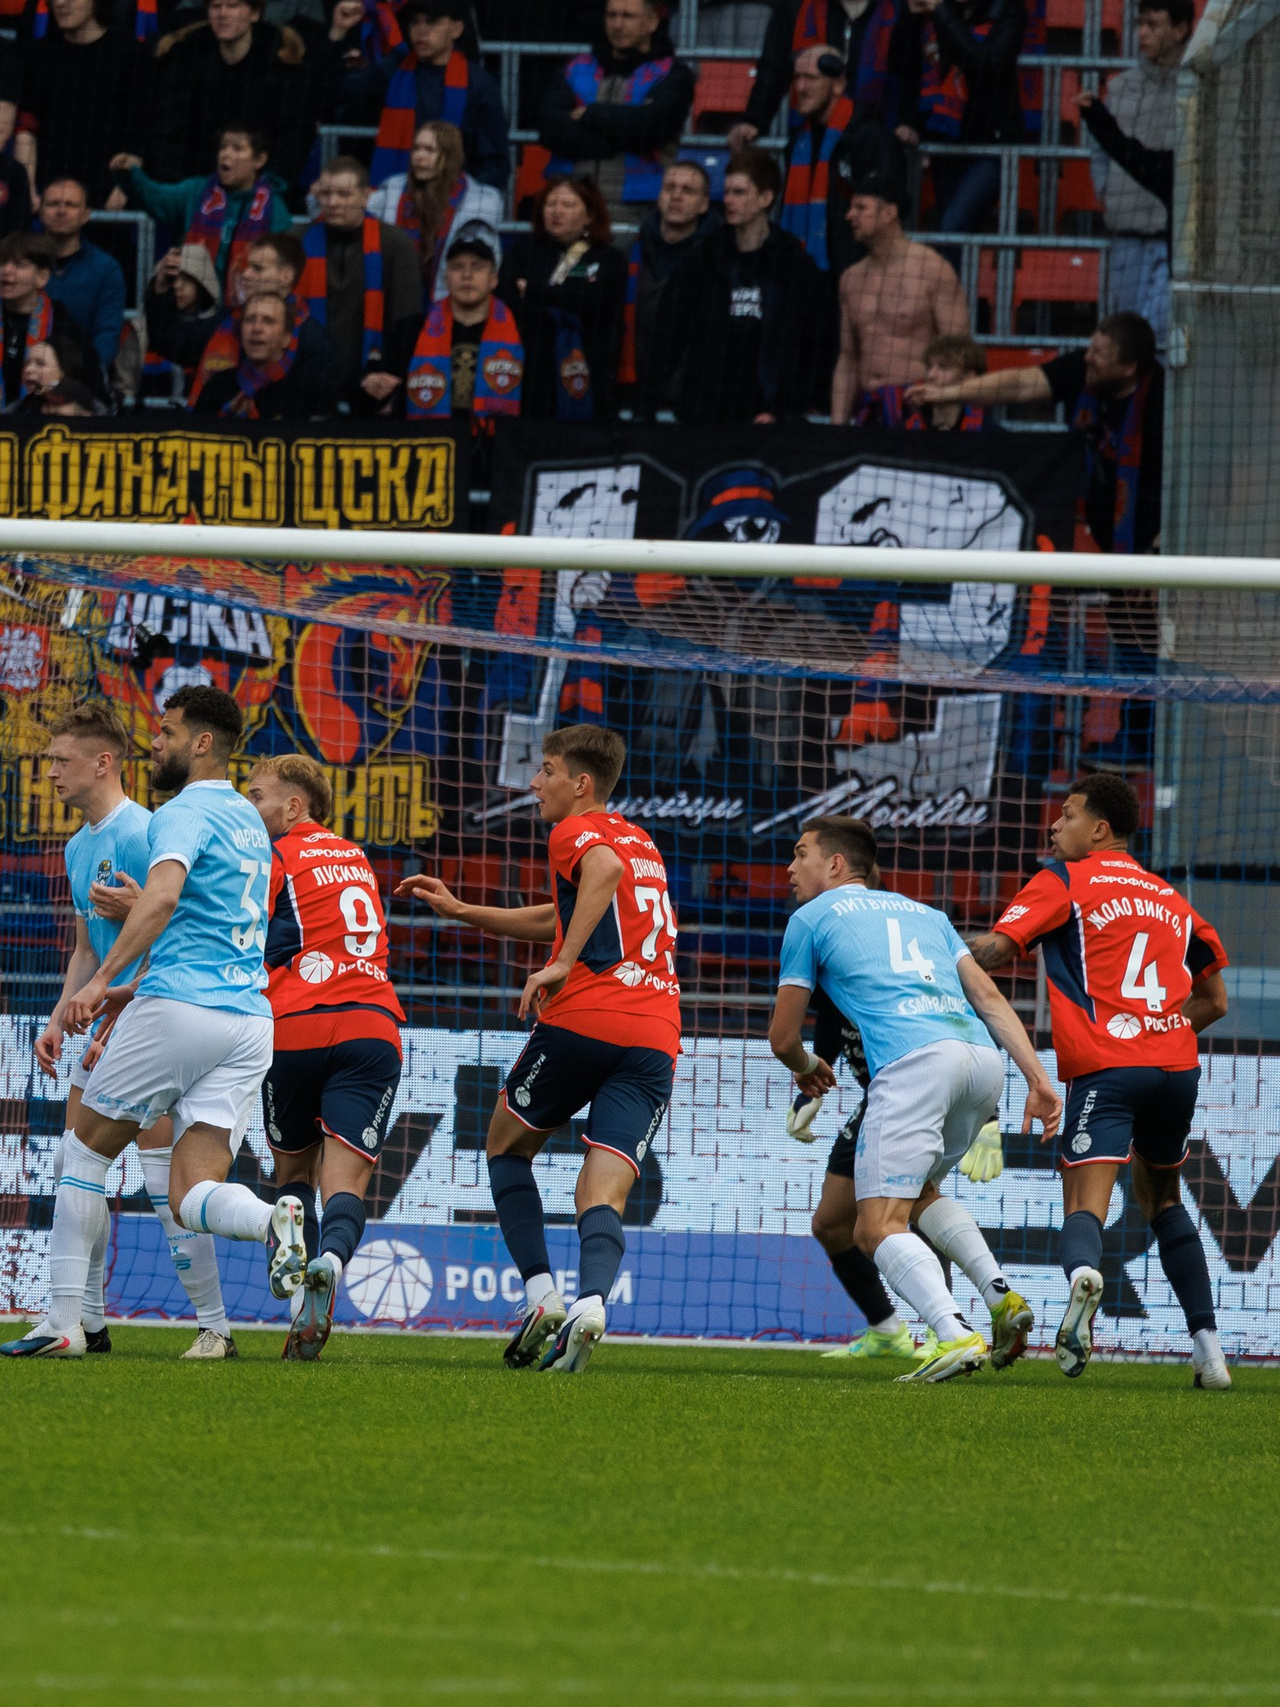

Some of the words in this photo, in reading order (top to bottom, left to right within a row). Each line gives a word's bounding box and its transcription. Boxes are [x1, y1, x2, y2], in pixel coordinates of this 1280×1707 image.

[28, 428, 280, 523] ФАНАТЫ
[297, 441, 452, 530] ЦСКА
[299, 848, 360, 860] АЭРОФЛОТ
[312, 864, 376, 891] ЛУСИАНО
[1089, 875, 1160, 893] АЭРОФЛОТ
[339, 886, 382, 957] 9
[831, 897, 928, 917] ЛИТВИНОВ
[1087, 896, 1133, 931] ЖОАО
[886, 917, 937, 983] 4
[1121, 931, 1167, 1012] 4
[372, 1085, 394, 1130] РОССЕТИ
[445, 1265, 632, 1305] РОСЕИ
